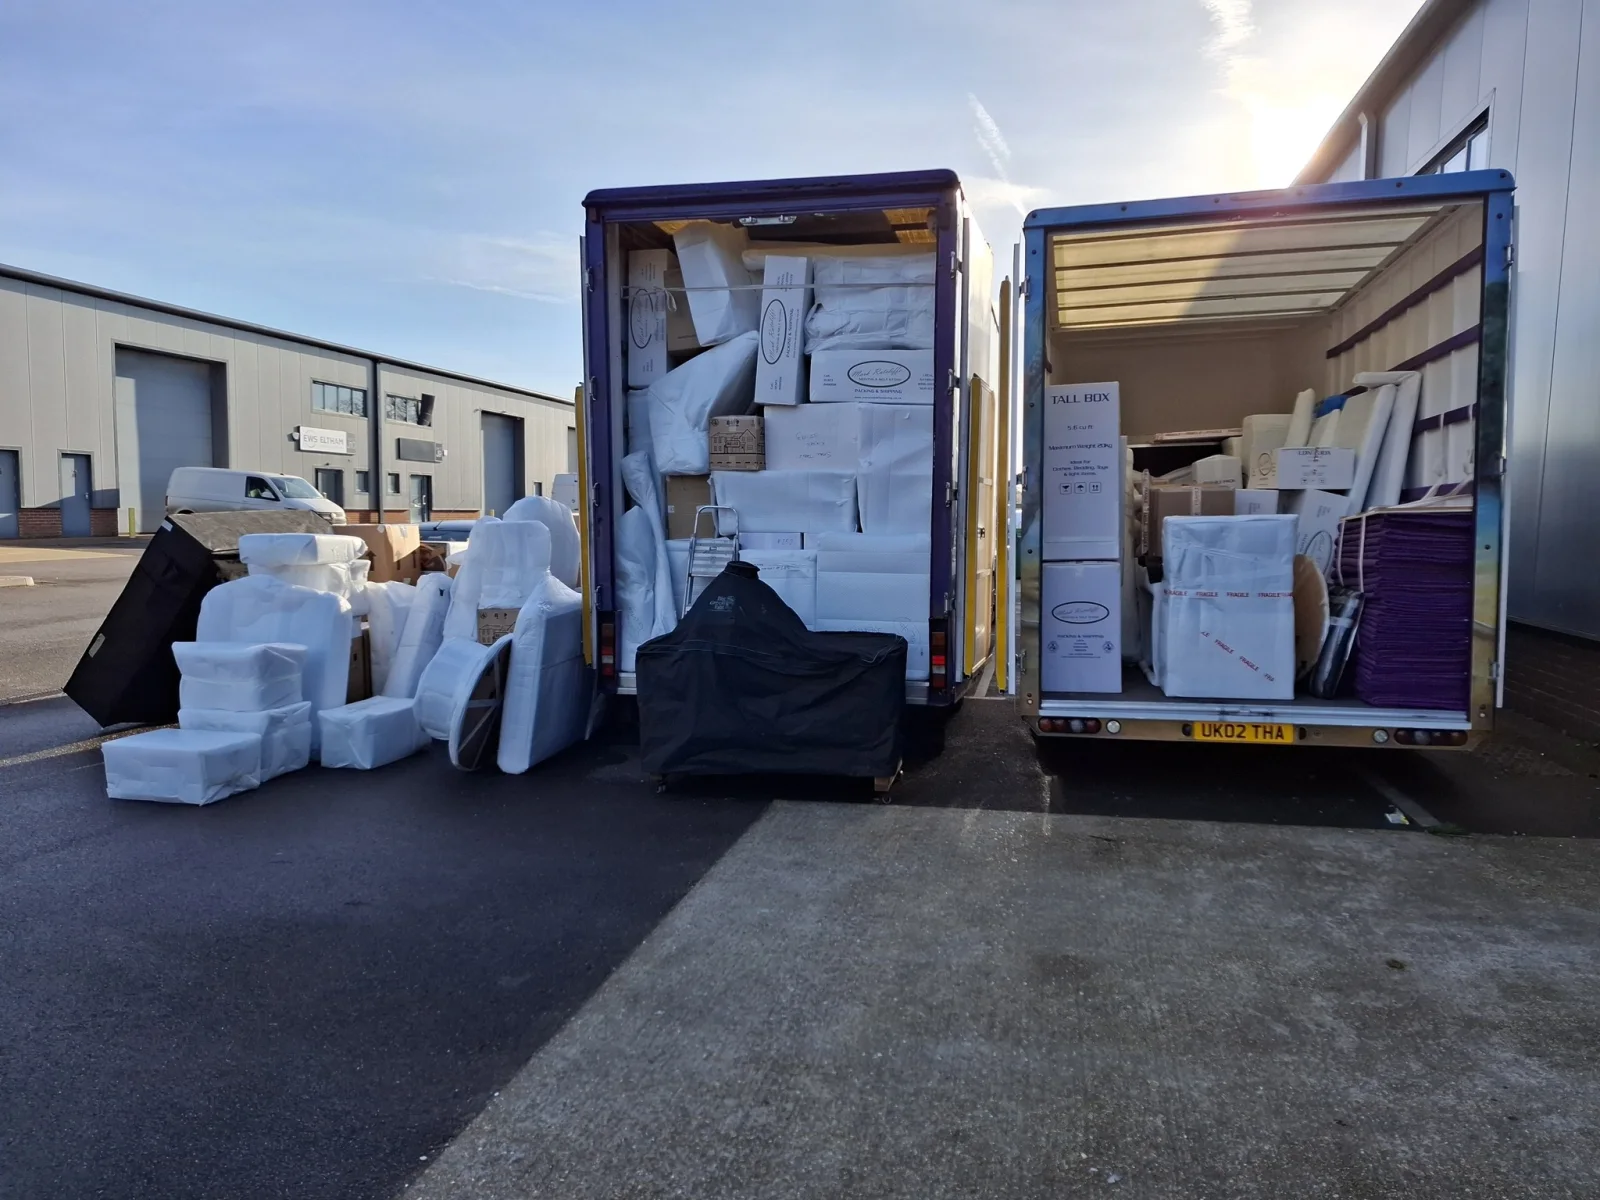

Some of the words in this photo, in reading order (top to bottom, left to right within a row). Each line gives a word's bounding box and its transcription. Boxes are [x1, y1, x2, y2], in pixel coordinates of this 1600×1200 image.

[1052, 394, 1080, 404] TALL
[1084, 392, 1110, 402] BOX
[304, 434, 318, 442] EWS
[320, 436, 344, 445] ELTHAM
[1214, 639, 1234, 654] FRAGILE
[1240, 656, 1259, 672] FRAGILE
[1202, 723, 1246, 738] UK02
[1252, 724, 1284, 740] THA
